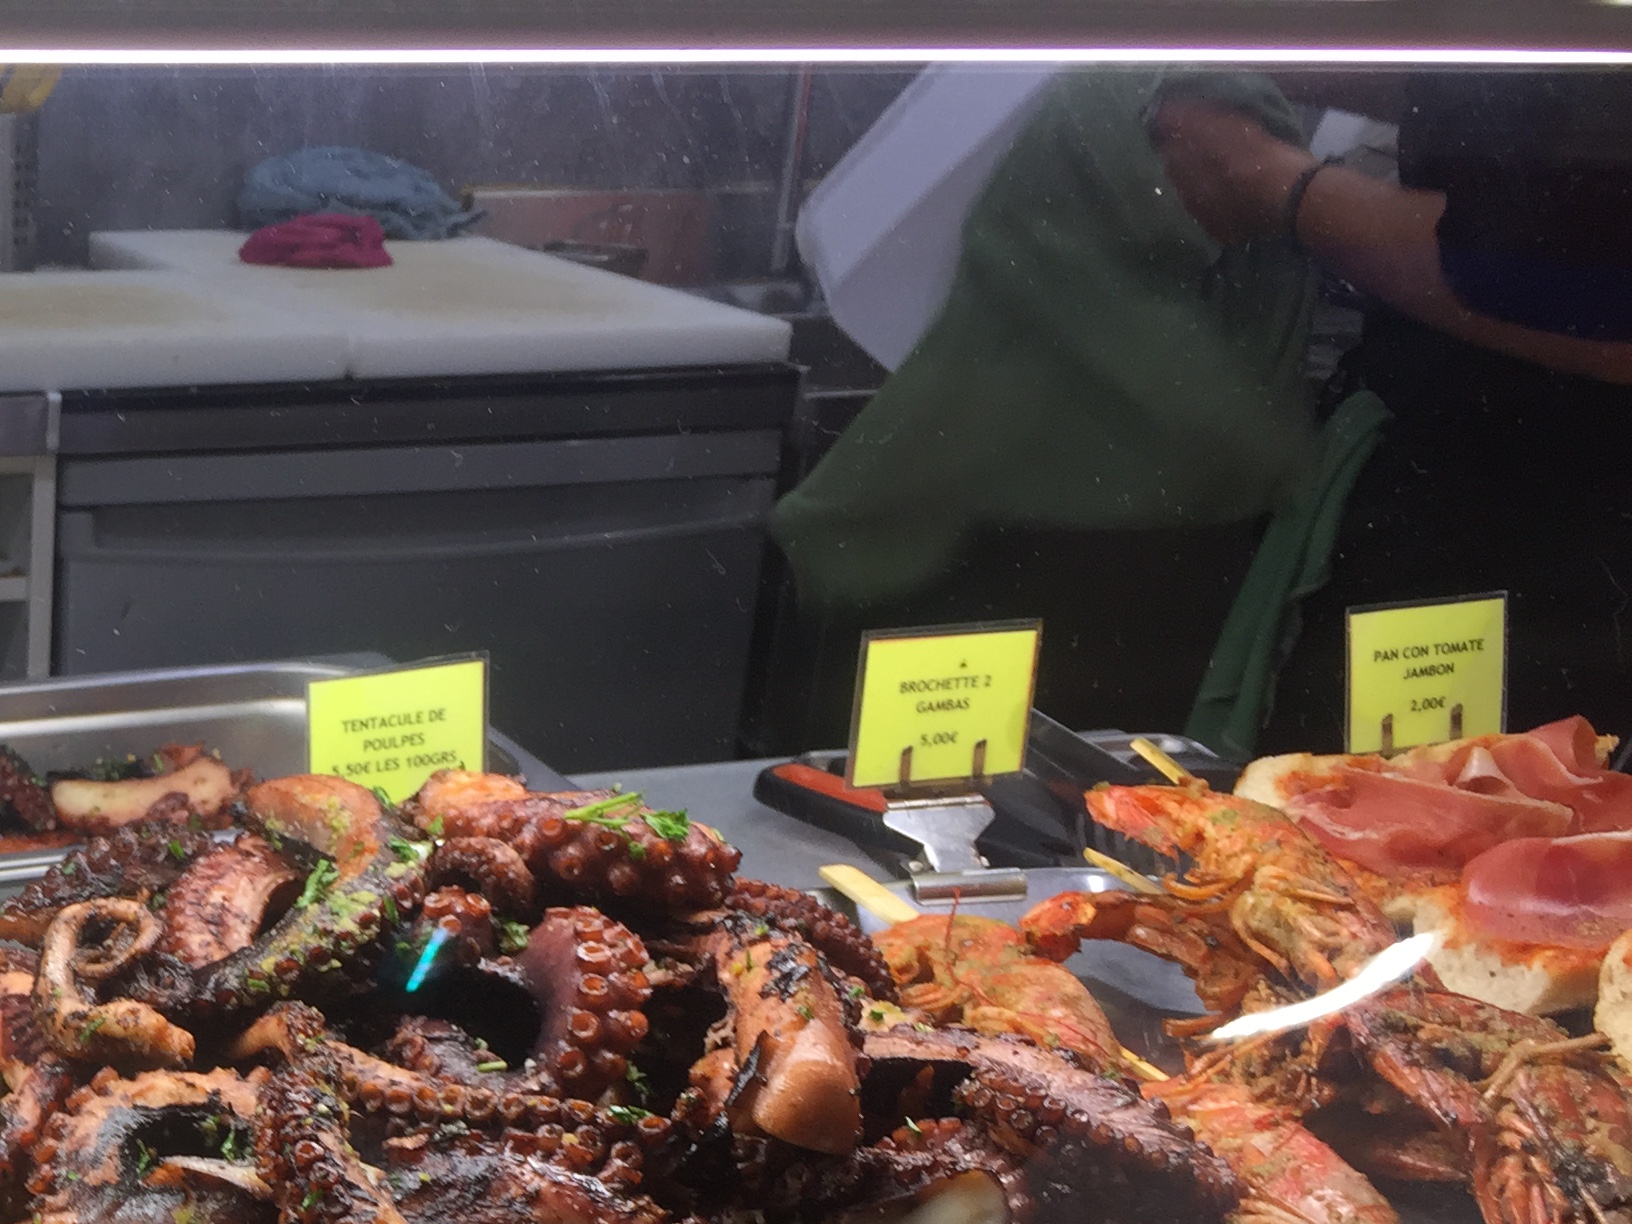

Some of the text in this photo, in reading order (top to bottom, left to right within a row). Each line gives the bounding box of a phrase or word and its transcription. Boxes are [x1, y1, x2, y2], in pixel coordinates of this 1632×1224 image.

[1373, 638, 1485, 662] PAN CON TOMATE
[1403, 663, 1455, 680] JAMBON
[899, 675, 992, 694] BROCHETTE 2
[916, 698, 971, 713] GAMBAS
[1410, 696, 1446, 713] 2,00€
[341, 708, 446, 733] TENTACULE DE
[363, 733, 425, 752] POULPES
[920, 731, 958, 748] 5,00€
[376, 758, 400, 773] LES
[406, 750, 457, 768] 100GRS
